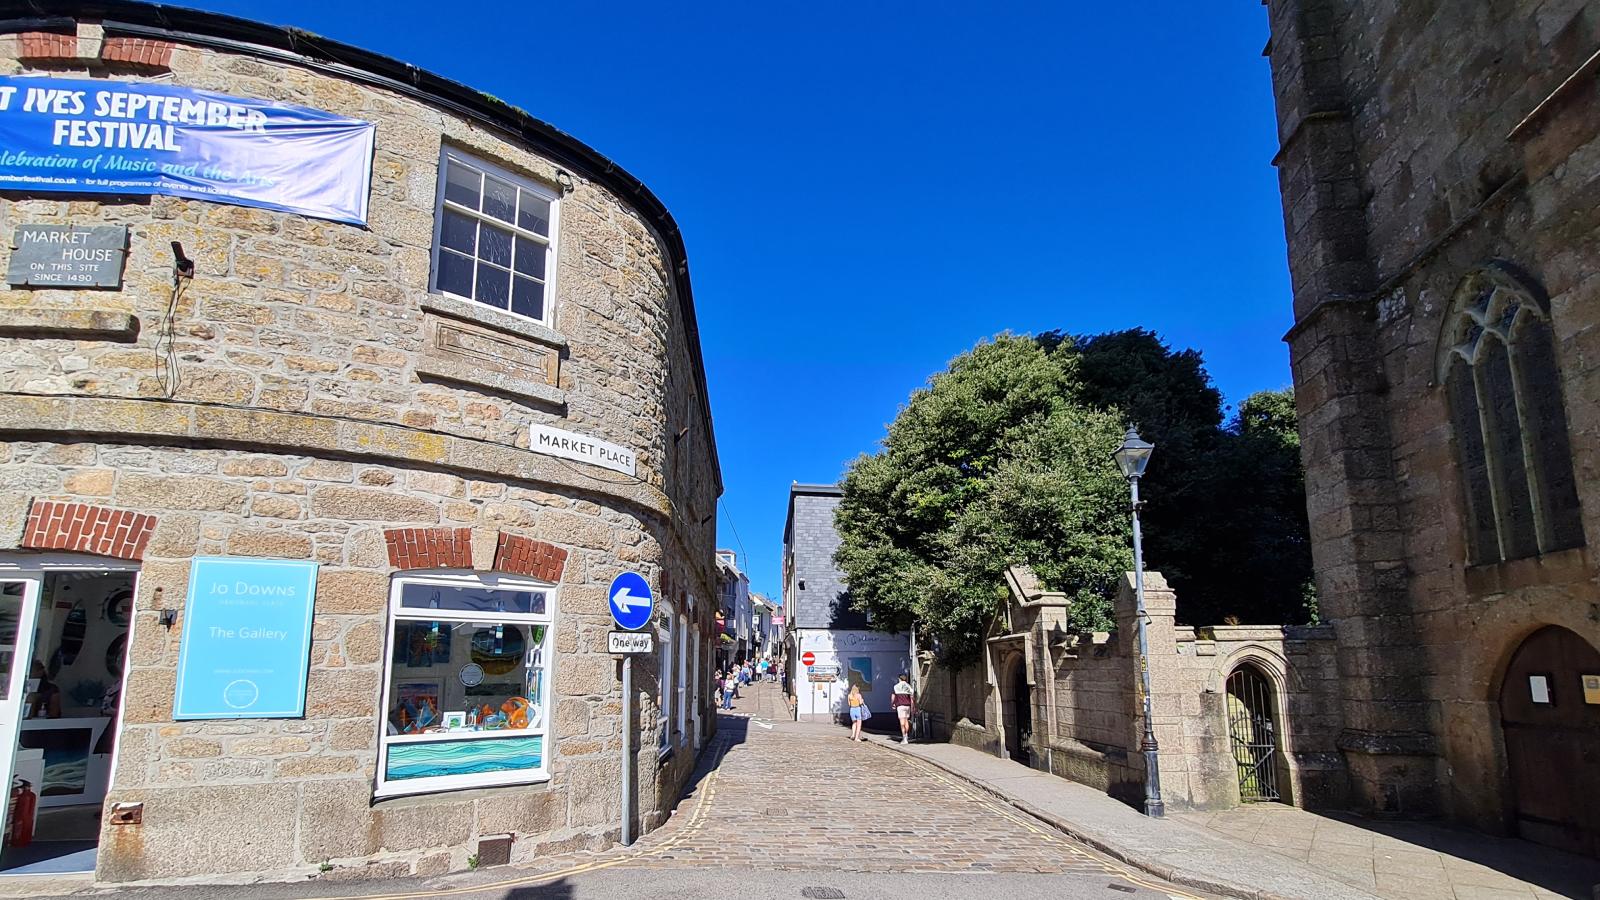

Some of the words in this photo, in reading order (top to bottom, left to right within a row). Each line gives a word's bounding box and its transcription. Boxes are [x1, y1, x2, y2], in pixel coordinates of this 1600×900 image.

[23, 87, 86, 115] IVES
[94, 91, 268, 134] SEPTEMBER
[53, 120, 181, 152] FESTIVAL
[0, 150, 78, 169] lebration
[82, 154, 103, 173] of
[104, 155, 156, 172] Music
[162, 161, 199, 177] and
[203, 164, 232, 181] the
[237, 170, 275, 187] Arts
[109, 180, 152, 188] programme
[23, 231, 91, 244] MARKET
[62, 248, 113, 262] HOUSE
[30, 262, 45, 270] ON
[51, 263, 72, 271] THIS
[79, 264, 100, 272] SITE
[34, 273, 62, 281] SINCE
[67, 274, 92, 282] 1490
[539, 433, 595, 456] MARKET
[599, 447, 631, 467] PLACE
[209, 626, 235, 639] The
[239, 627, 288, 641] Gallery
[612, 637, 630, 648] One
[632, 640, 649, 649] way
